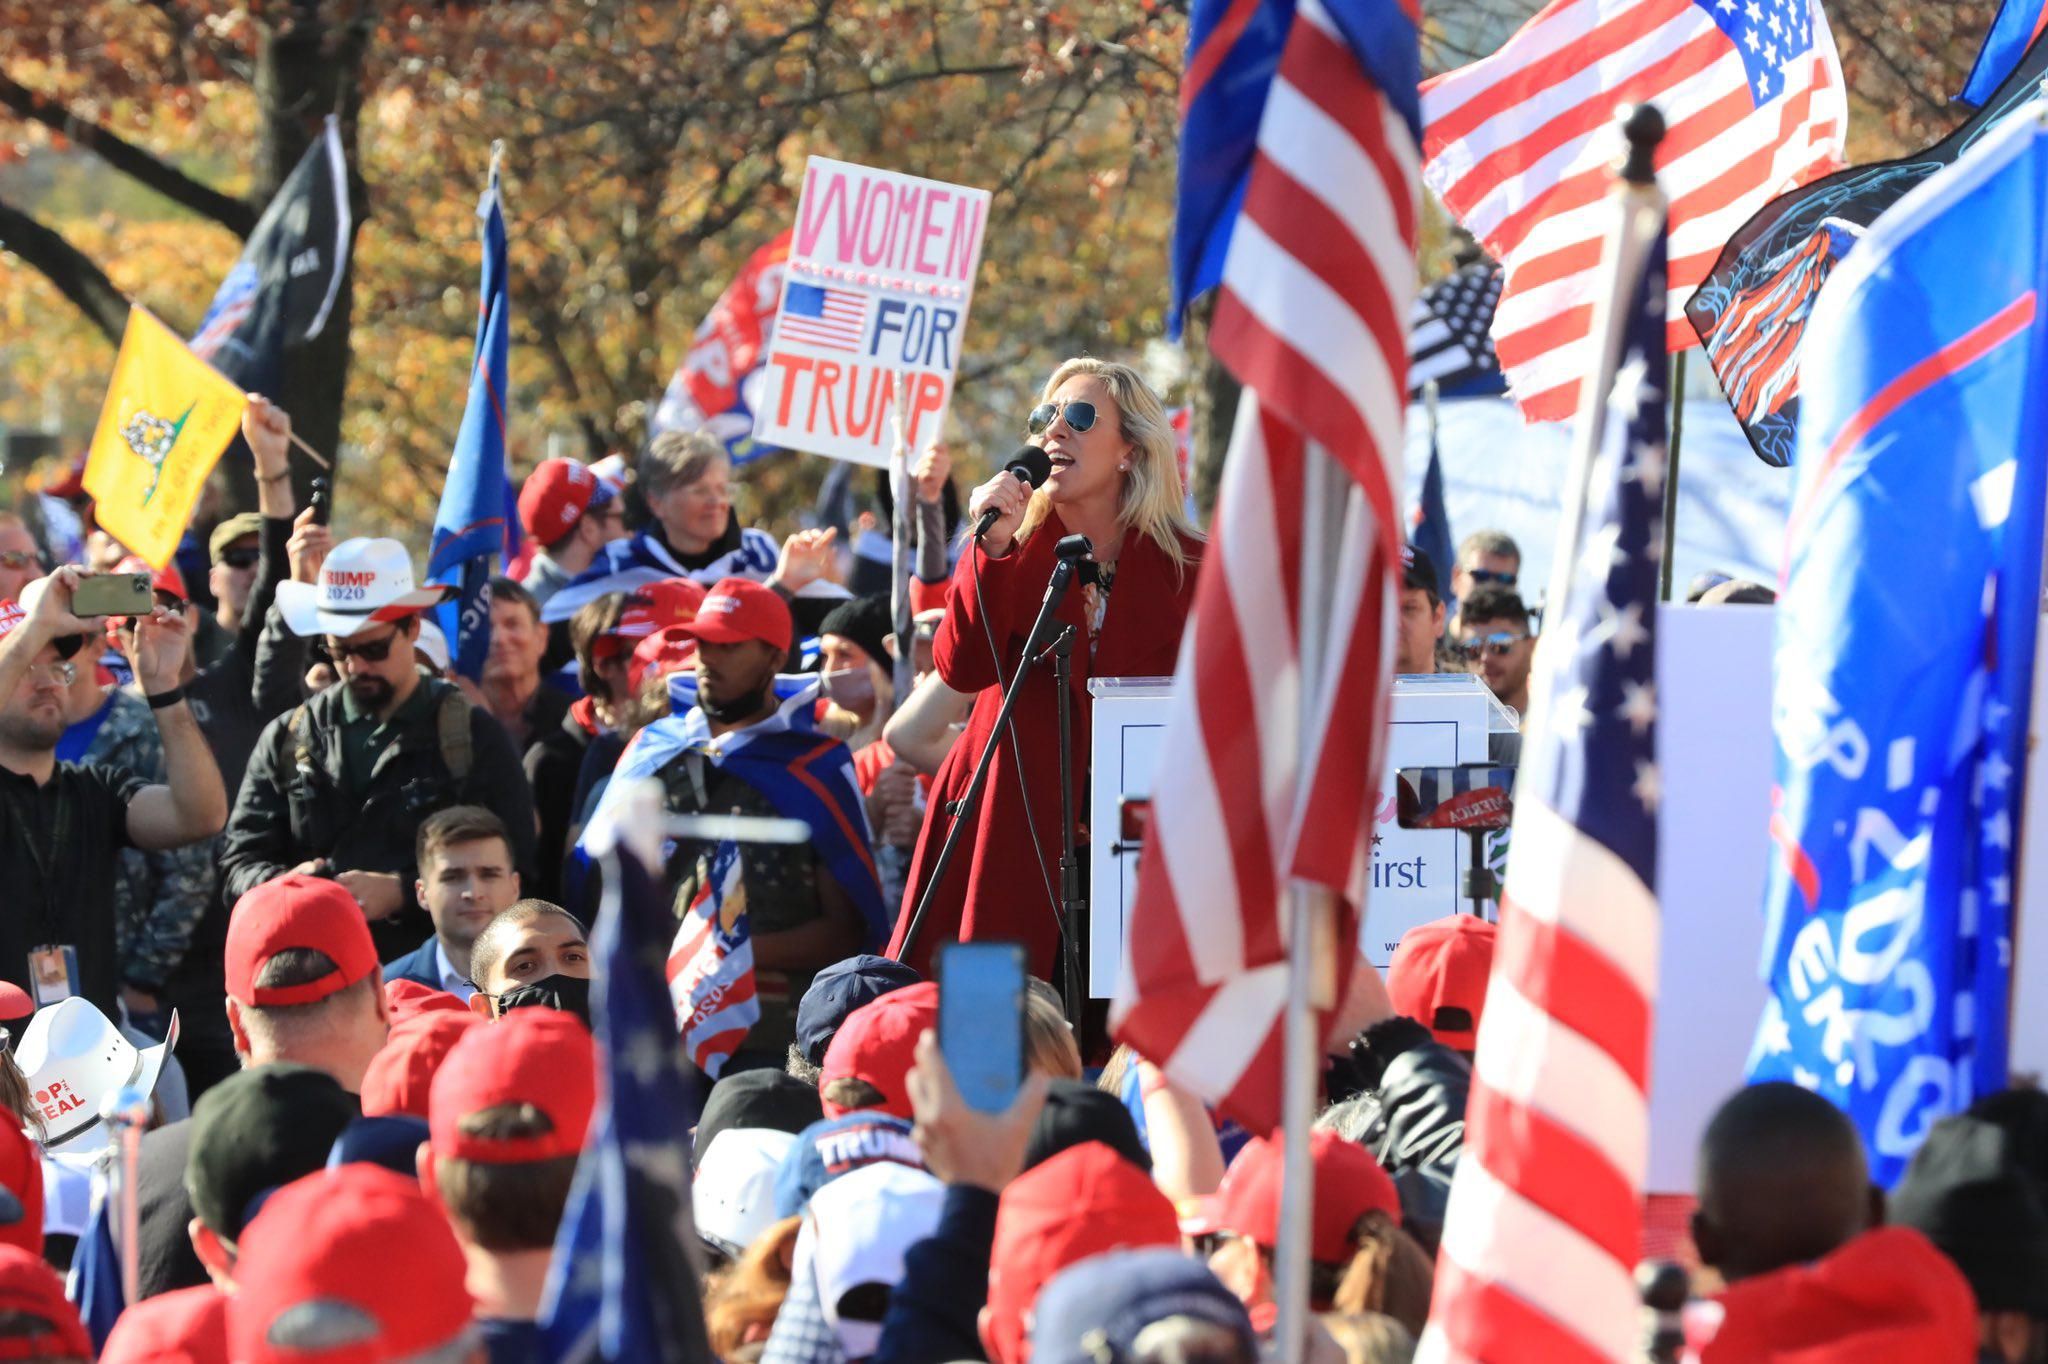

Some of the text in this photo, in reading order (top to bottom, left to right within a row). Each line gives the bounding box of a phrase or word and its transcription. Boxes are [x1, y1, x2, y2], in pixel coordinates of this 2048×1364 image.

[796, 167, 983, 281] WOMEN
[869, 297, 959, 370] FOR
[772, 352, 944, 452] TRUMP
[324, 571, 376, 587] RUMP
[1368, 850, 1428, 888] irst
[34, 1079, 71, 1104] OP THE
[40, 1093, 86, 1120] EAL
[815, 1128, 923, 1169] TRUM
